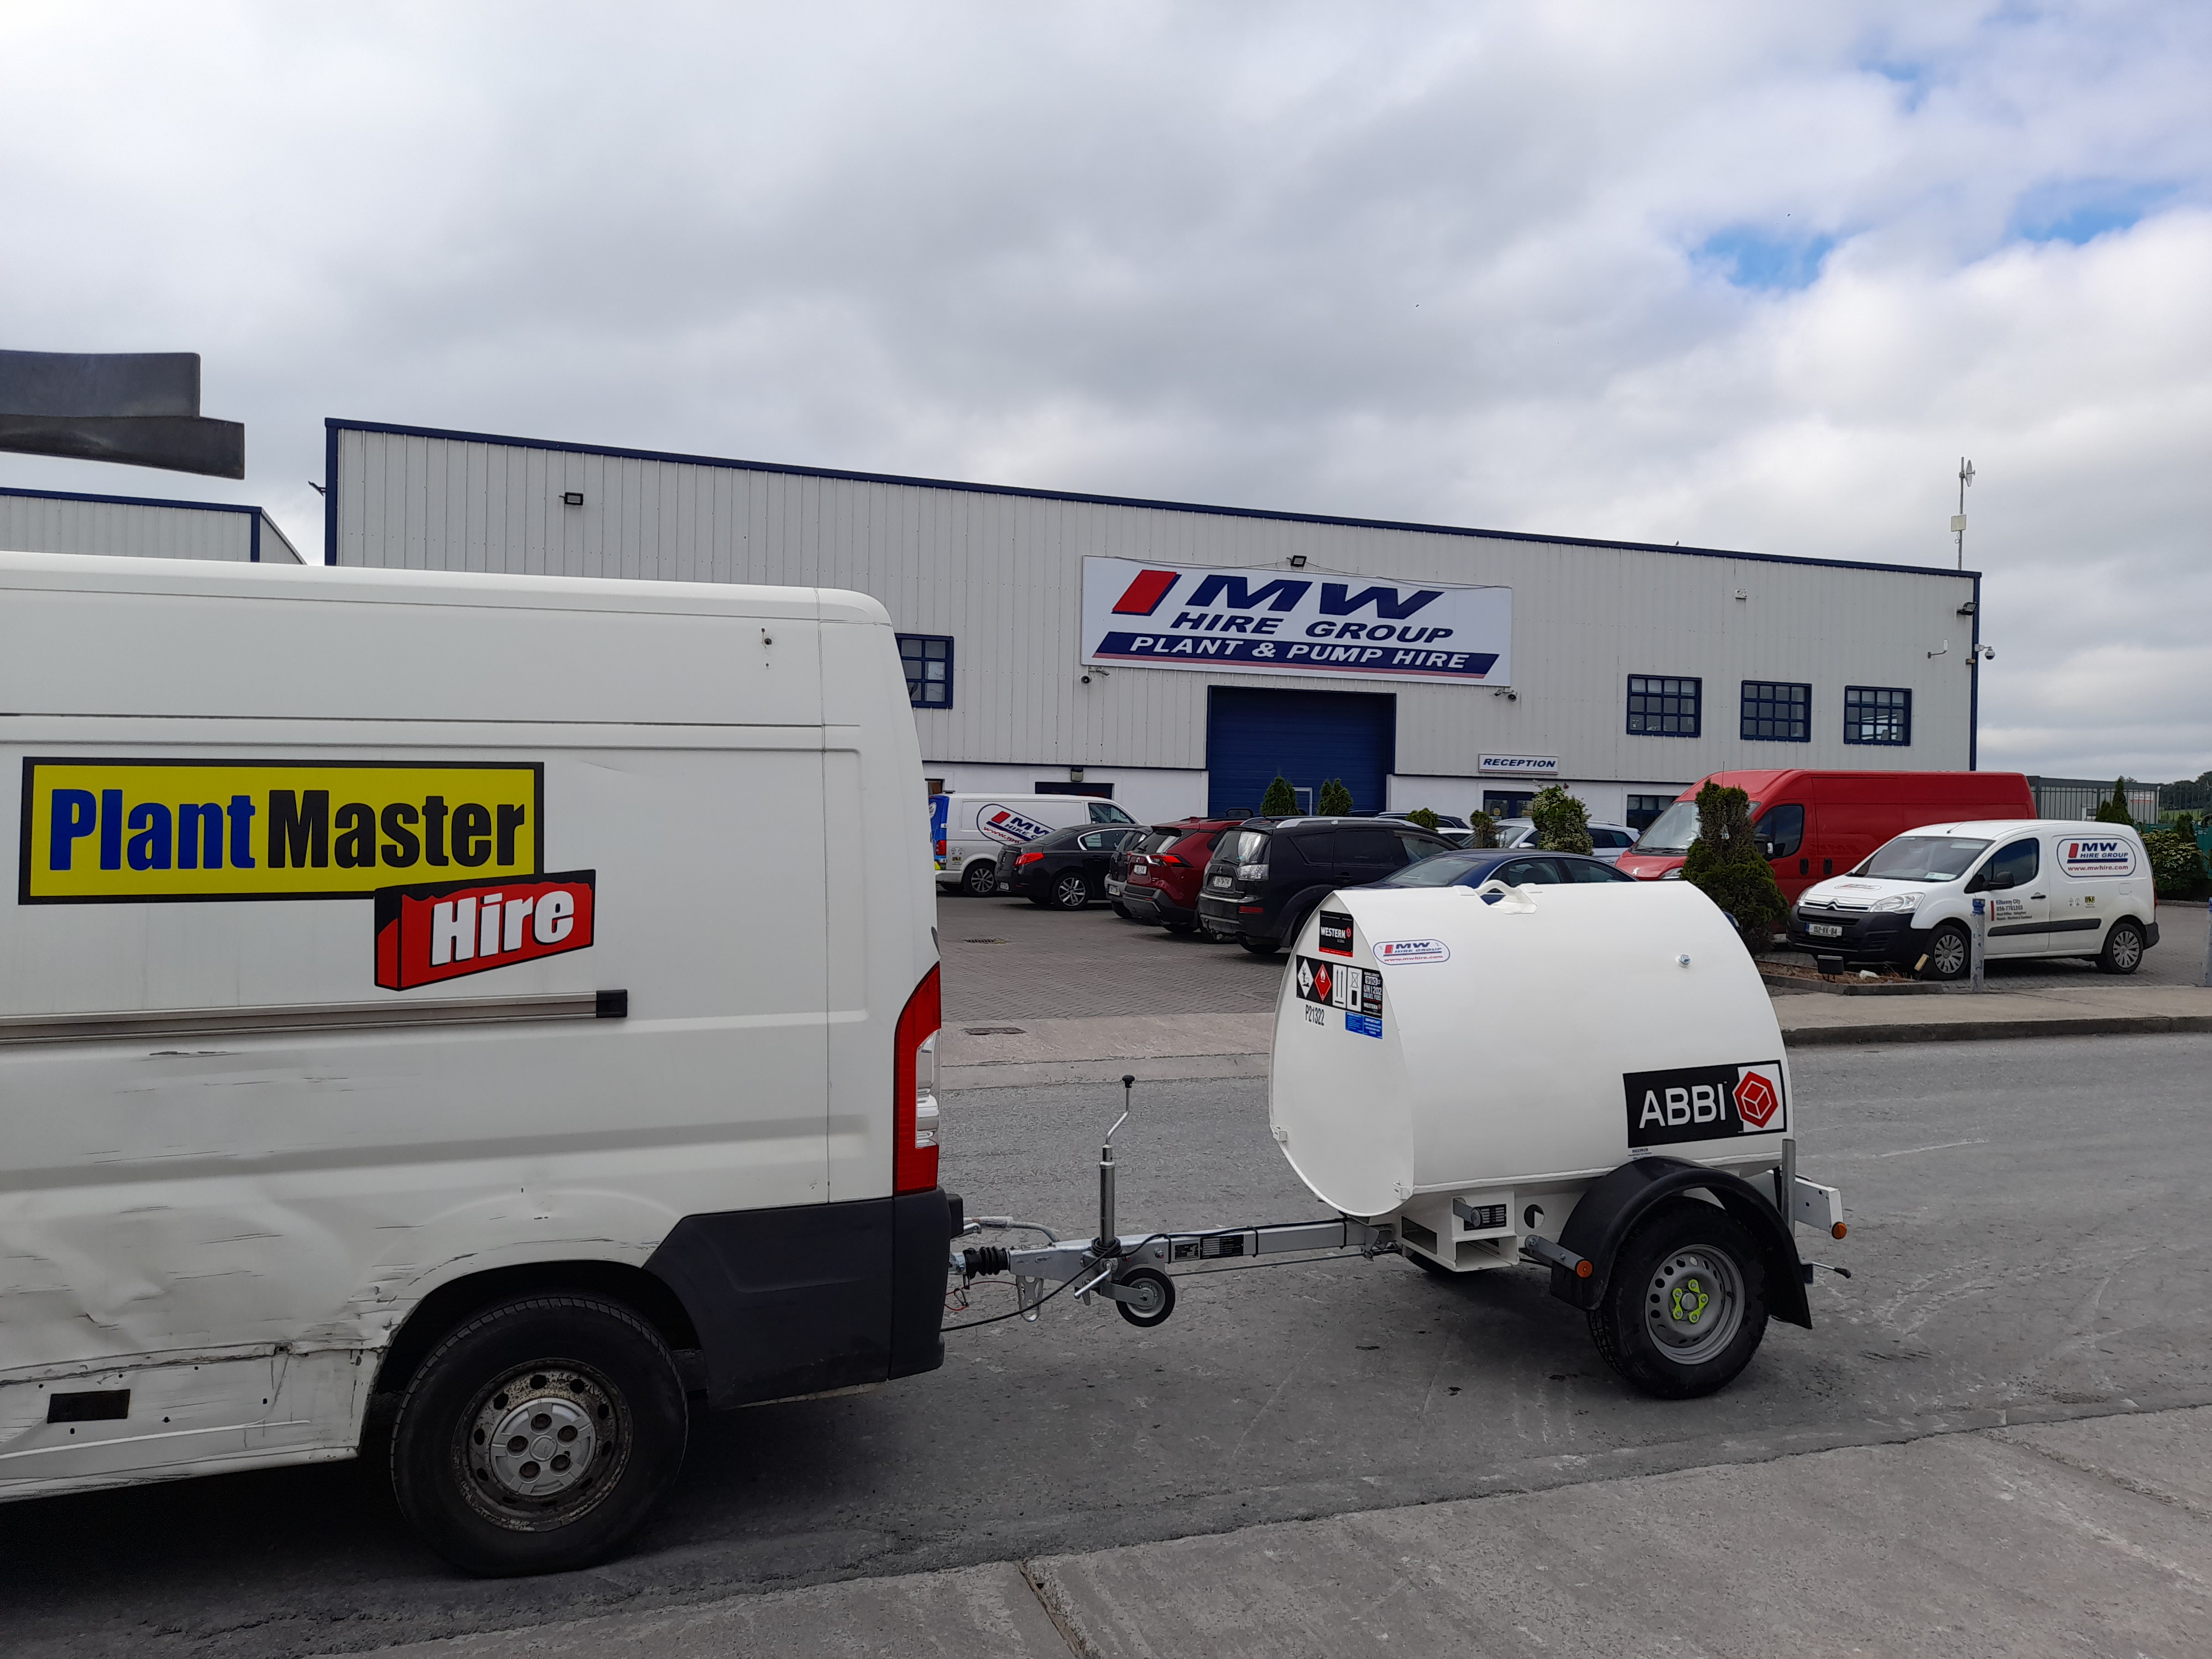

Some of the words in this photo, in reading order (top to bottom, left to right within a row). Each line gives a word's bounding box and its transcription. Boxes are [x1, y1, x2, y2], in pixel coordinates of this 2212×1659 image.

[1185, 574, 1445, 620] MW
[1170, 612, 1285, 635] HIRE
[1305, 620, 1454, 644] GROUP
[1129, 637, 1244, 656] PLANT
[1251, 641, 1276, 659] &
[1286, 645, 1383, 664] PUMP
[1393, 651, 1470, 669] HIRE
[1483, 758, 1556, 768] RECEPTION
[49, 789, 256, 871] Plant
[268, 790, 525, 869] Master
[1004, 823, 1031, 836] HIRE
[2081, 843, 2117, 852] MW
[430, 889, 576, 966] Hire
[1321, 926, 1346, 939] WESTERN
[1366, 977, 1377, 985] 990
[1305, 1004, 1324, 1026] P21322
[1639, 1083, 1726, 1129] ABBI
